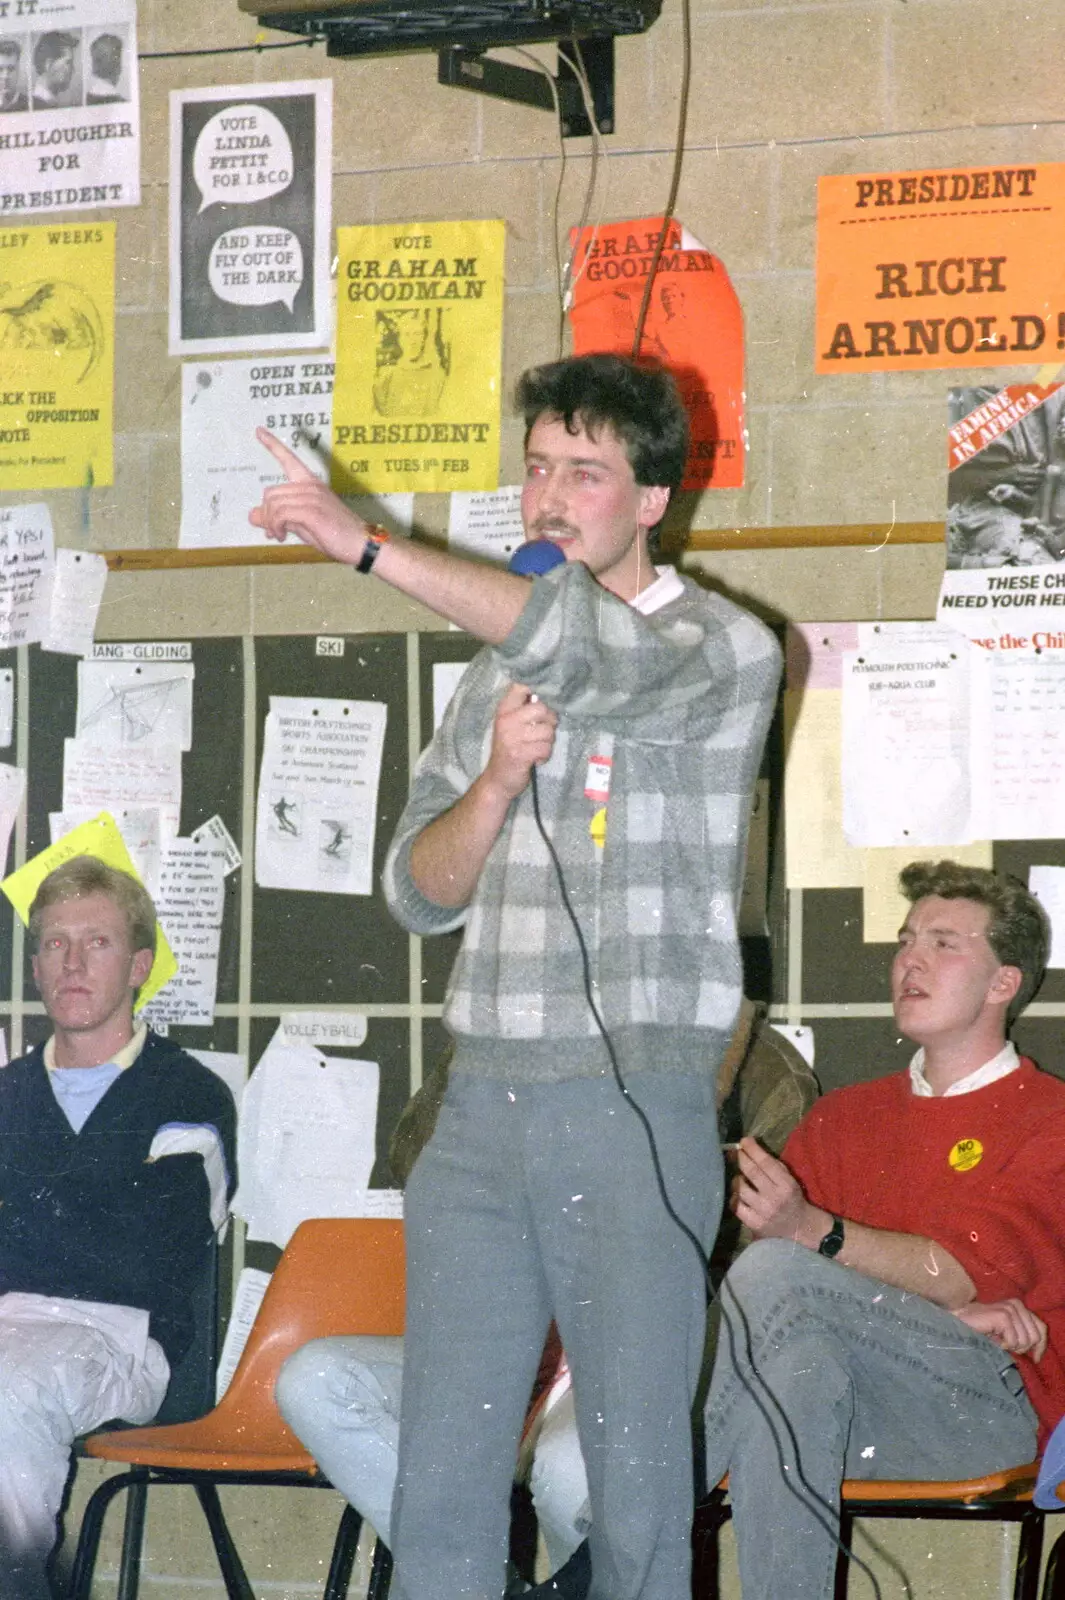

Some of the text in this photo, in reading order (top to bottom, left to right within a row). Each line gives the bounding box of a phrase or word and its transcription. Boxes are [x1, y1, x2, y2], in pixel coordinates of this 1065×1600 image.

[220, 116, 257, 131] VOTE
[38, 122, 133, 145] LOUGHER
[215, 134, 272, 150] LINDA
[39, 154, 80, 172] FOR
[209, 153, 268, 169] PETTIT
[212, 173, 240, 188] FOR
[855, 169, 1037, 208] PRESIDENT
[2, 184, 122, 210] PRESIDENT
[48, 230, 103, 245] WEEKS
[218, 233, 293, 250] AND KEEP
[393, 235, 432, 250] VOTE
[215, 251, 294, 268] FLY OUT OF
[347, 257, 478, 279] GRAHAM
[222, 271, 250, 286] THE
[875, 256, 1007, 300] RICH
[347, 279, 487, 302] GOODMAN
[250, 365, 296, 380] OPEN
[28, 391, 56, 405] THE
[26, 408, 100, 423] OPPOSITION
[949, 390, 1013, 443] FAMINE
[334, 423, 490, 445] PRESIDENT
[952, 391, 1040, 462] IN AFRICA
[350, 460, 370, 473] ON
[384, 459, 420, 473] TUES
[442, 459, 470, 473] FEB
[987, 575, 1040, 590] THESE
[942, 595, 988, 608] NEED
[991, 594, 1037, 608] YOUR
[319, 641, 341, 654] SKI
[999, 633, 1028, 649] the
[1032, 631, 1065, 649] Chi
[133, 645, 188, 658] GLIDING
[852, 660, 950, 673] PLYMOUTH POLYTECHNIC
[914, 679, 936, 689] CLUB
[957, 1140, 974, 1154] NO
